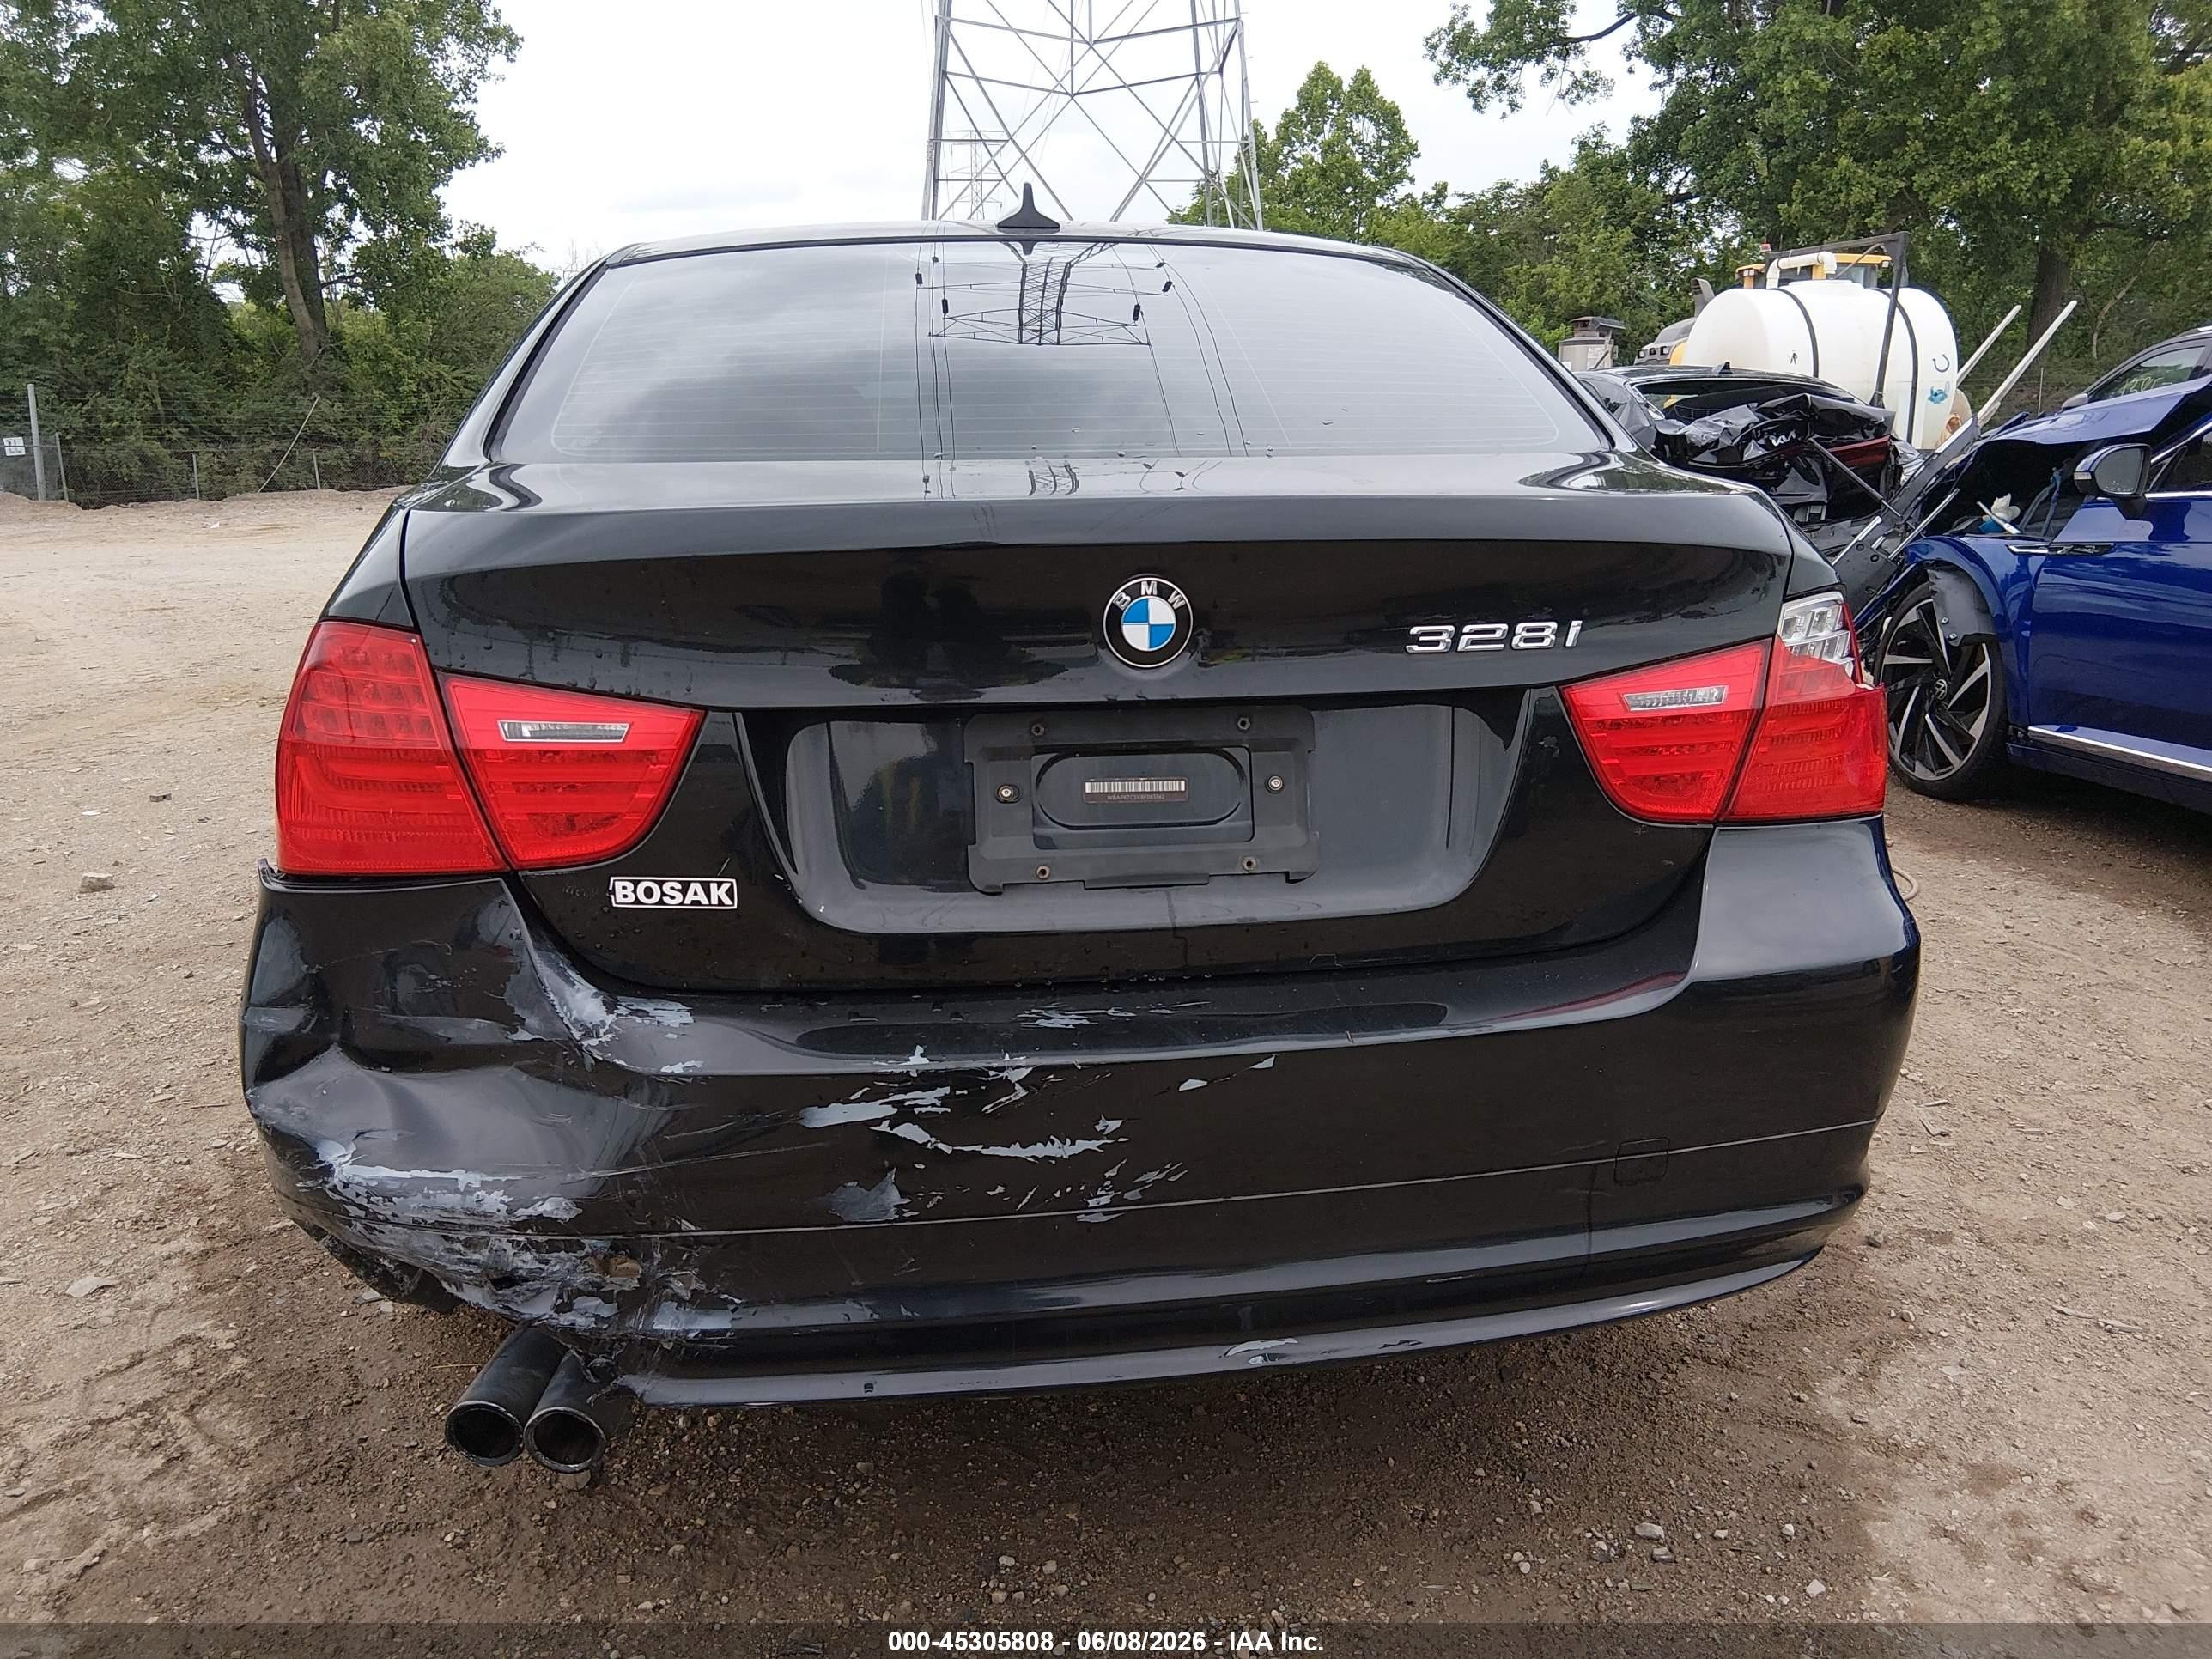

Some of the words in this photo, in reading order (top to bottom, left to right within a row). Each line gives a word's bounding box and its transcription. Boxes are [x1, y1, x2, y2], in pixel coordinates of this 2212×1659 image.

[1113, 580, 1186, 611] BMW
[1405, 620, 1583, 653] 328i
[614, 880, 733, 906] BOSAK
